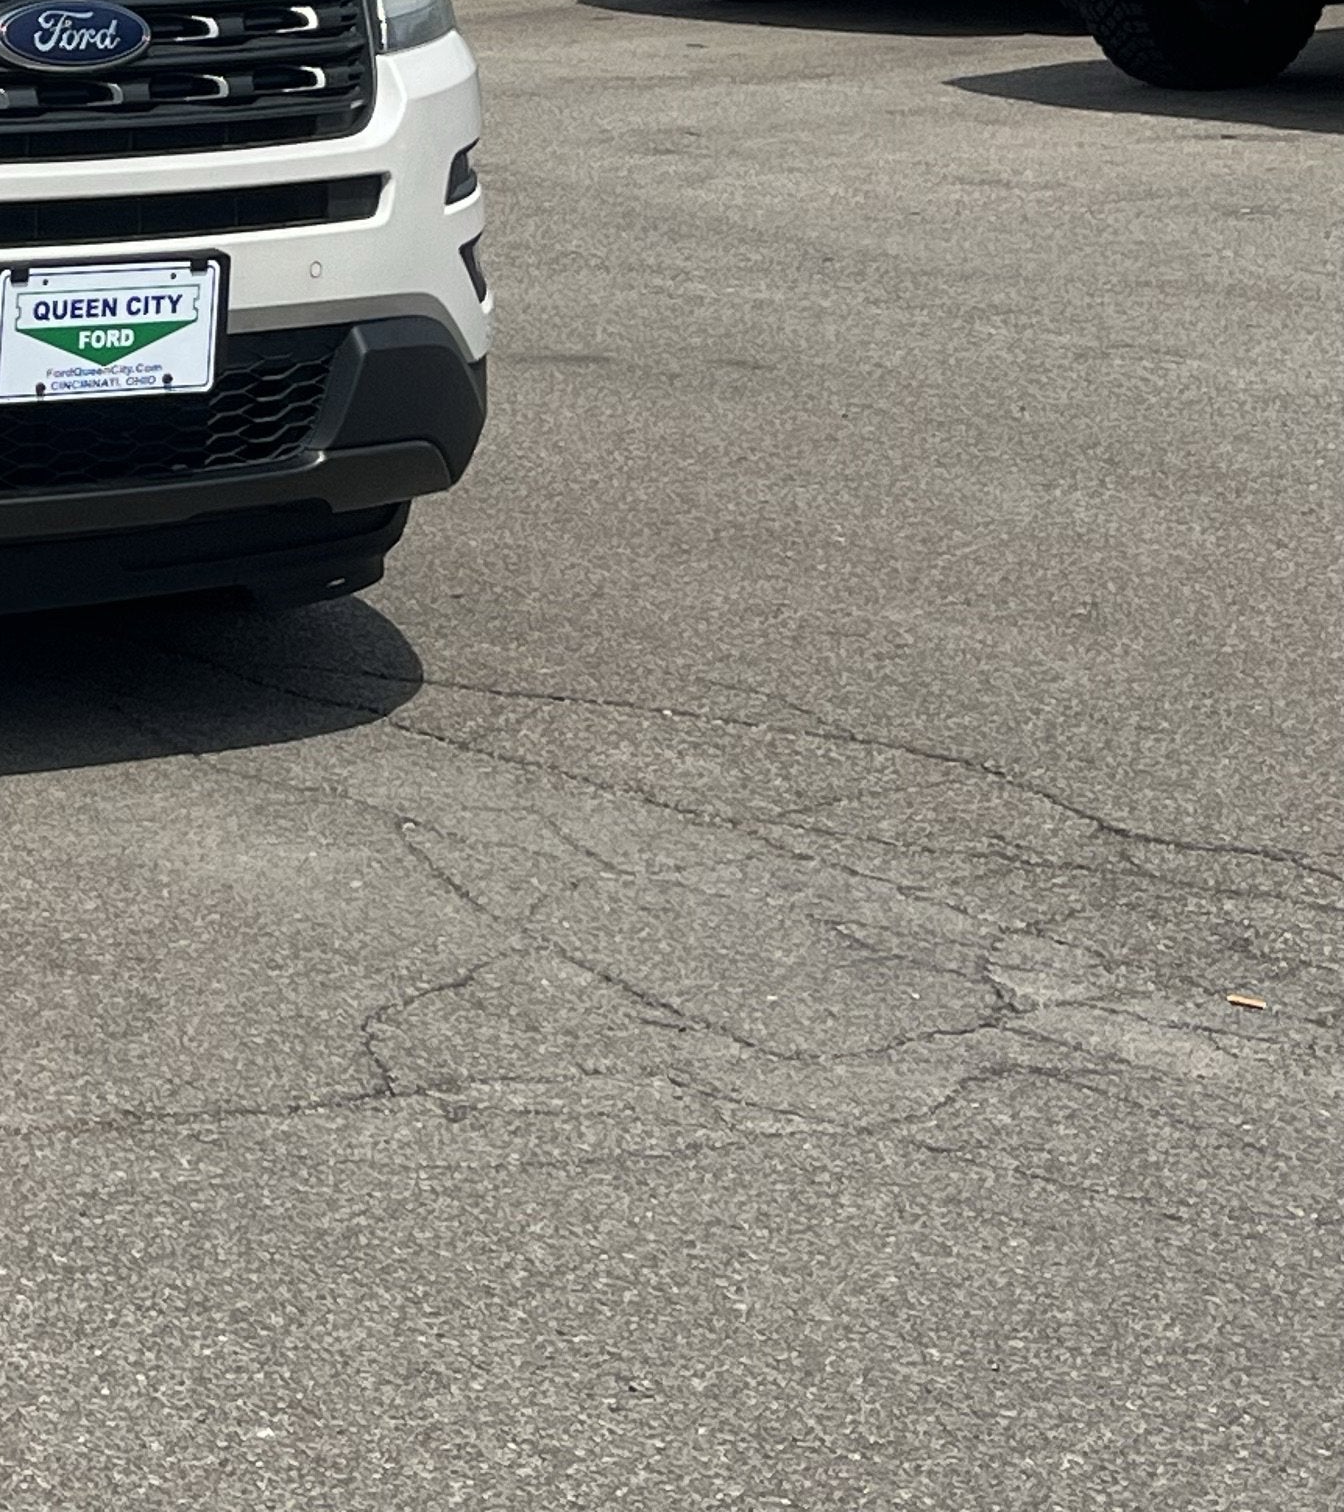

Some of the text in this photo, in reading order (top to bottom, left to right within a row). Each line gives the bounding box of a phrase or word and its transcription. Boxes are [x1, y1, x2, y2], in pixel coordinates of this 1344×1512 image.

[33, 9, 122, 53] Ford
[33, 294, 183, 321] QUEEN CITY
[78, 329, 135, 350] FORD
[125, 374, 157, 387] OHIO
